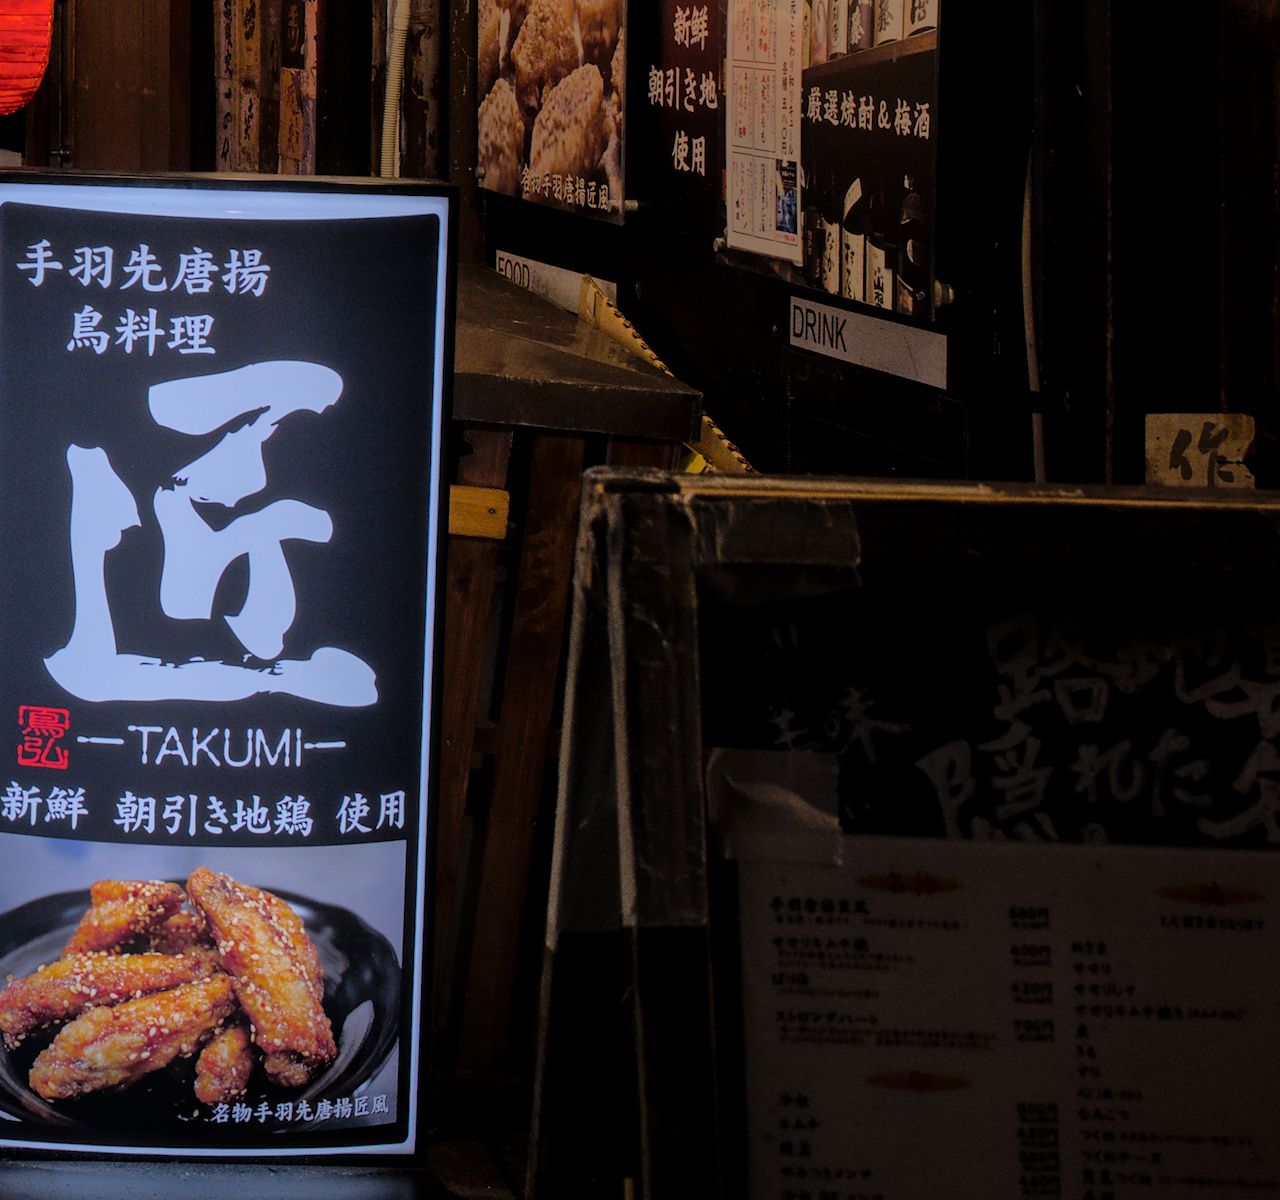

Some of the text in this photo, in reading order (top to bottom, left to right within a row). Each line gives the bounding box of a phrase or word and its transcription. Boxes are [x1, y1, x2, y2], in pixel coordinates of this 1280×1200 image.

[672, 4, 709, 52] 新鮮
[671, 130, 706, 177] 使用
[16, 238, 271, 298] 手羽先唐揚
[497, 257, 532, 289] FOOD
[66, 304, 217, 357] 鳥料理
[792, 304, 848, 353] DRINK
[42, 360, 378, 707] 匠
[0, 780, 408, 838] 新鮮 朝引き地鶏 使用
[211, 1094, 390, 1124] 名物手羽先唐揚匠風
